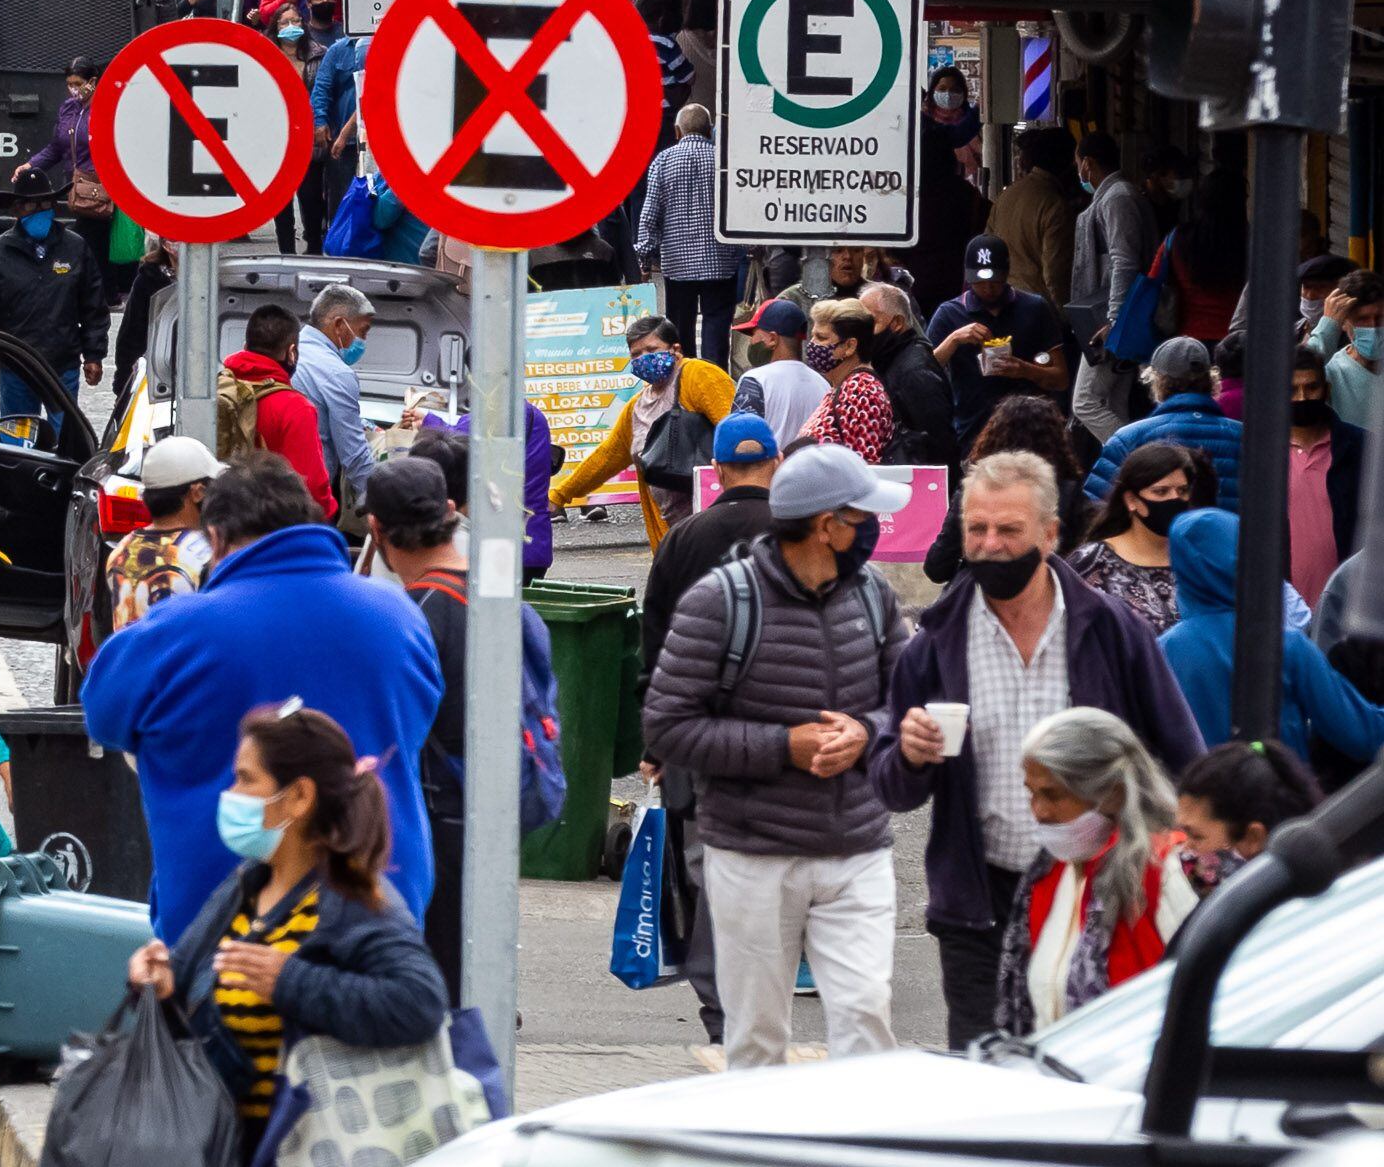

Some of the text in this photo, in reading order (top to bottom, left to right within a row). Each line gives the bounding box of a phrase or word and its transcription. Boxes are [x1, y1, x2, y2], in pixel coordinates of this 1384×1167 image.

[168, 64, 239, 197] E
[758, 135, 879, 158] RESERVADO
[735, 168, 903, 192] SUPERMERCADO
[764, 196, 868, 225] O'HIGGINS
[526, 359, 615, 376] TERGENTES
[526, 382, 553, 394] ALES
[556, 381, 582, 393] BEBE
[594, 377, 635, 391] ADULTO
[551, 394, 602, 410] LOZAS
